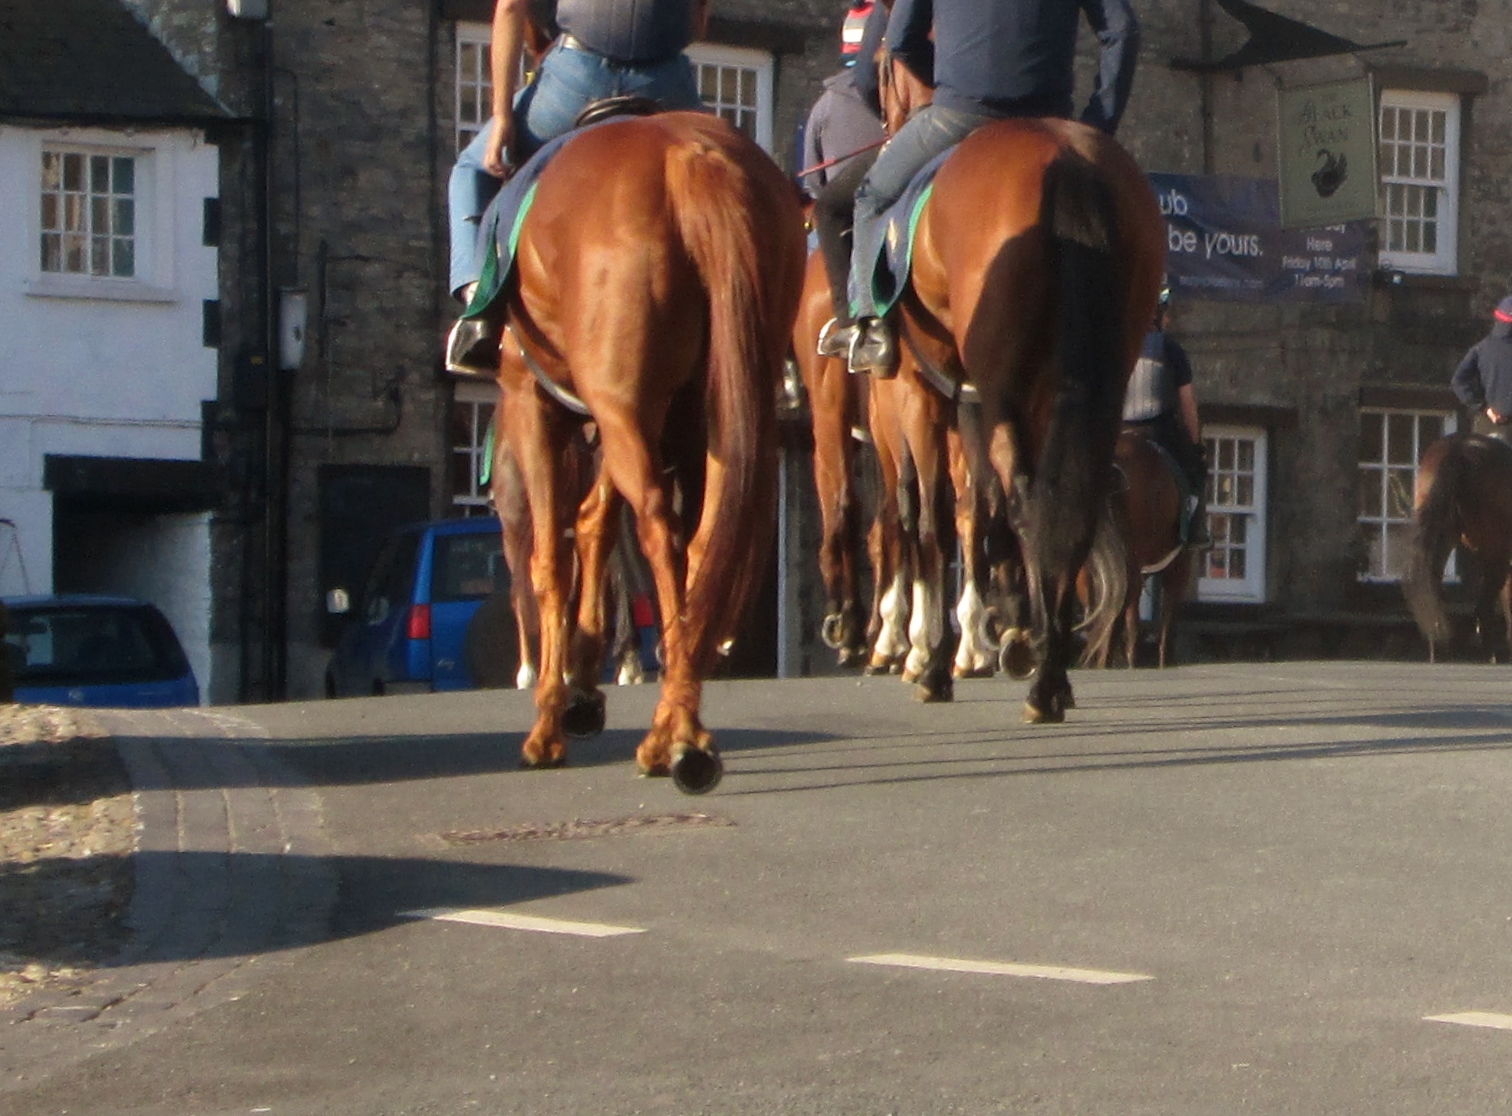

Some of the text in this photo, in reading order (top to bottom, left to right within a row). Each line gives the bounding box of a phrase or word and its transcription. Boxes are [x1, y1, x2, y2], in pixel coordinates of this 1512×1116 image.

[1160, 188, 1188, 216] ub
[1168, 224, 1264, 260] be yours.
[1306, 236, 1333, 252] Here
[1282, 255, 1311, 272] Friday
[1335, 257, 1357, 271] April
